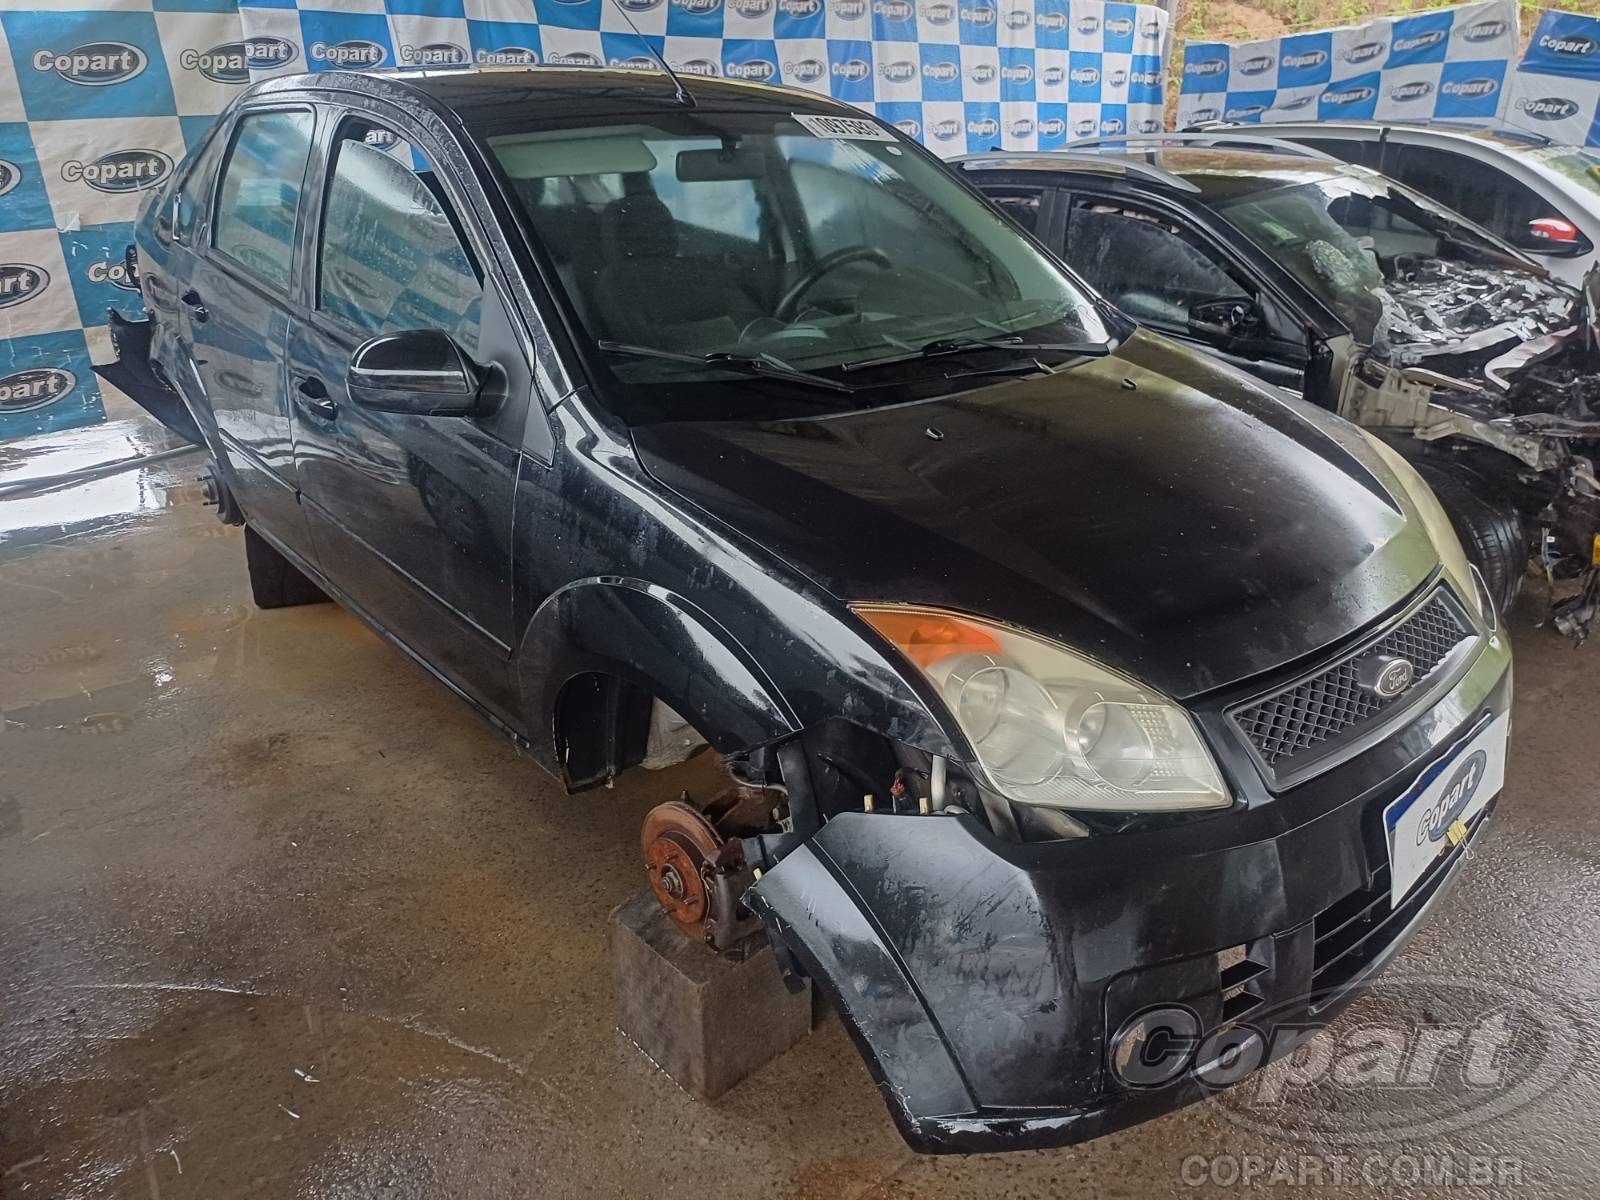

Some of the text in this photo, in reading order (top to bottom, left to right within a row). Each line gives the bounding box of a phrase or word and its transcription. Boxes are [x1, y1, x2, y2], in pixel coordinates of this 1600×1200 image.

[1539, 35, 1591, 53] Copart
[312, 43, 379, 65] Copart
[401, 44, 459, 63] Copart
[477, 50, 530, 64] Copart
[1282, 51, 1322, 68] Copart
[33, 50, 132, 76] Copart
[726, 62, 770, 79] Copart
[784, 61, 820, 78] Copart
[832, 62, 865, 78] Copart
[1321, 87, 1369, 104] Copart
[1441, 80, 1494, 94] Copart
[1516, 97, 1569, 115] Copart
[62, 156, 159, 183] Copart
[1388, 667, 1408, 690] Ford
[1416, 760, 1477, 847] Copart
